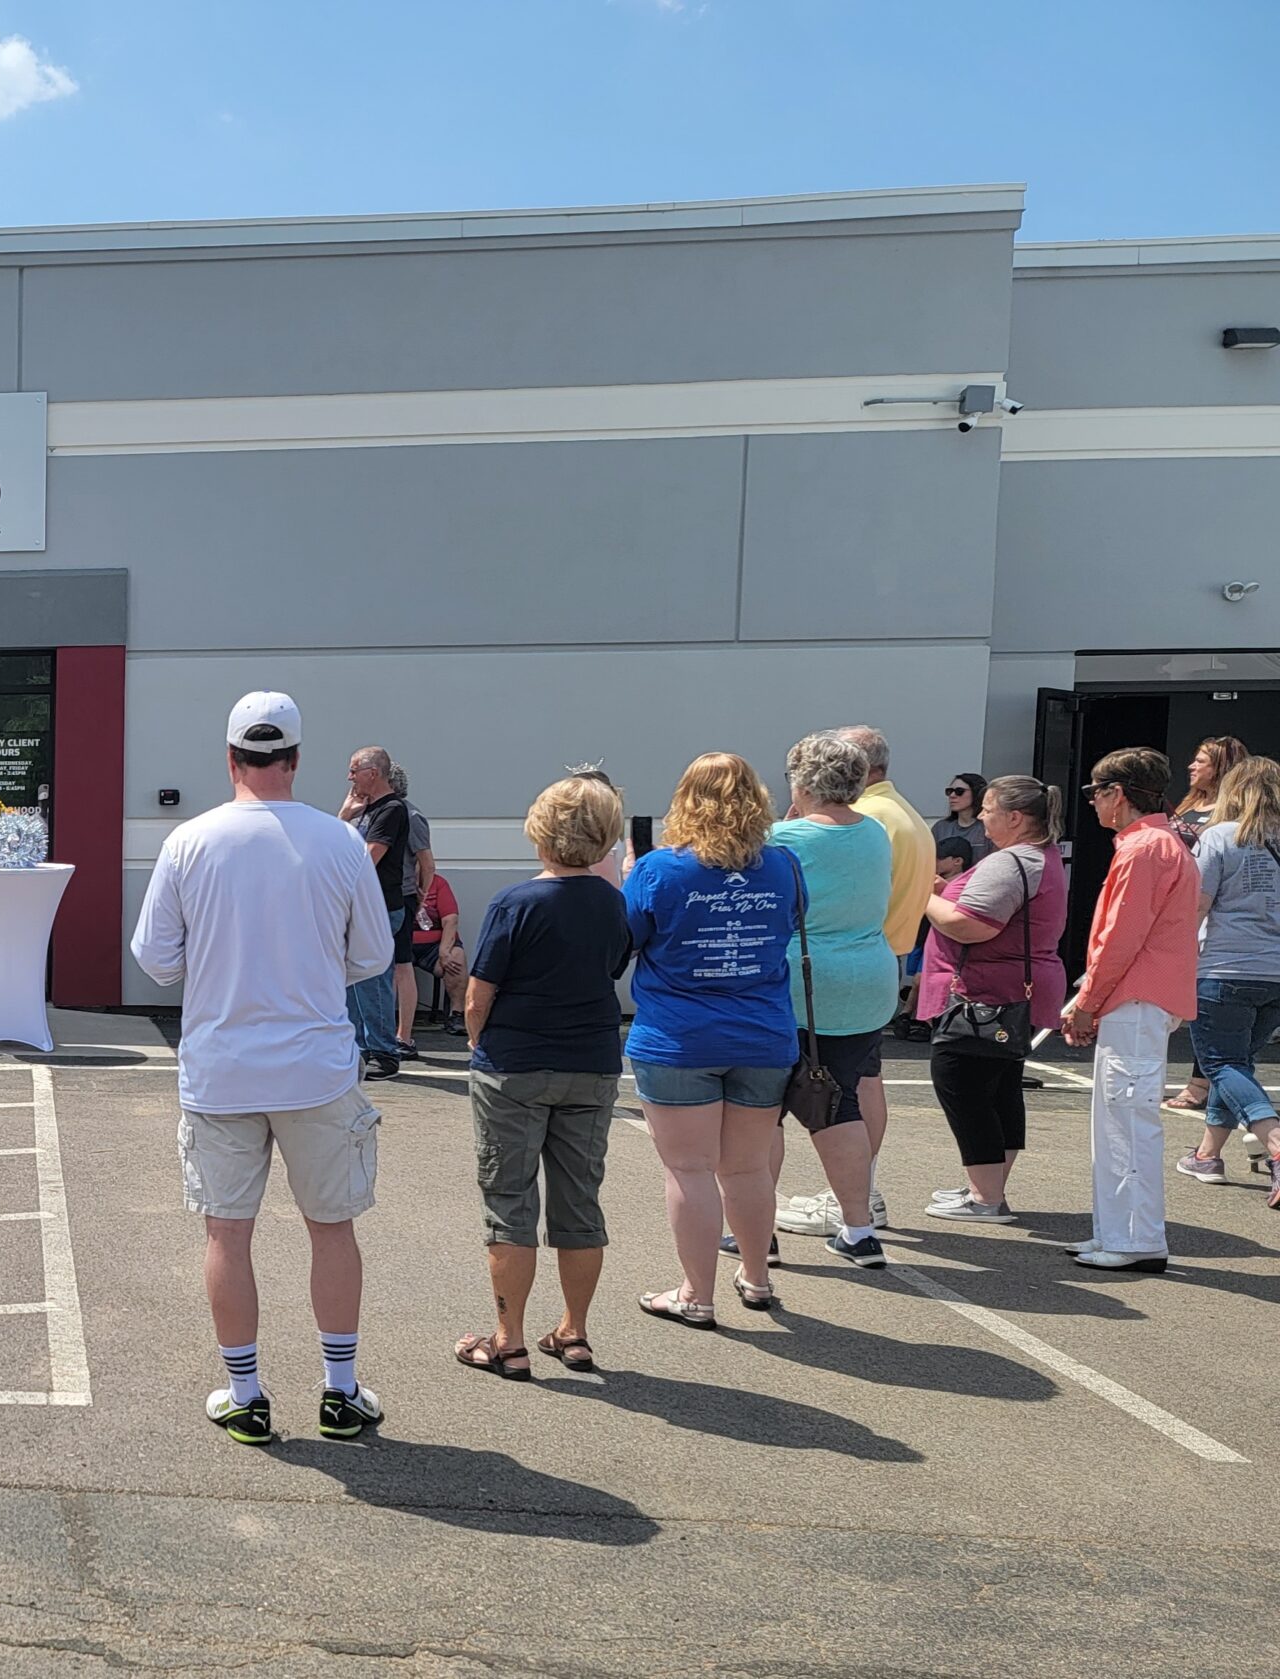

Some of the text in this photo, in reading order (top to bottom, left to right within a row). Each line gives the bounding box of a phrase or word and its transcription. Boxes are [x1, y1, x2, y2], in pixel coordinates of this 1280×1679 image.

[7, 739, 41, 747] CLIENT
[685, 890, 729, 909] Respect
[734, 900, 754, 913] No
[755, 900, 778, 911] One
